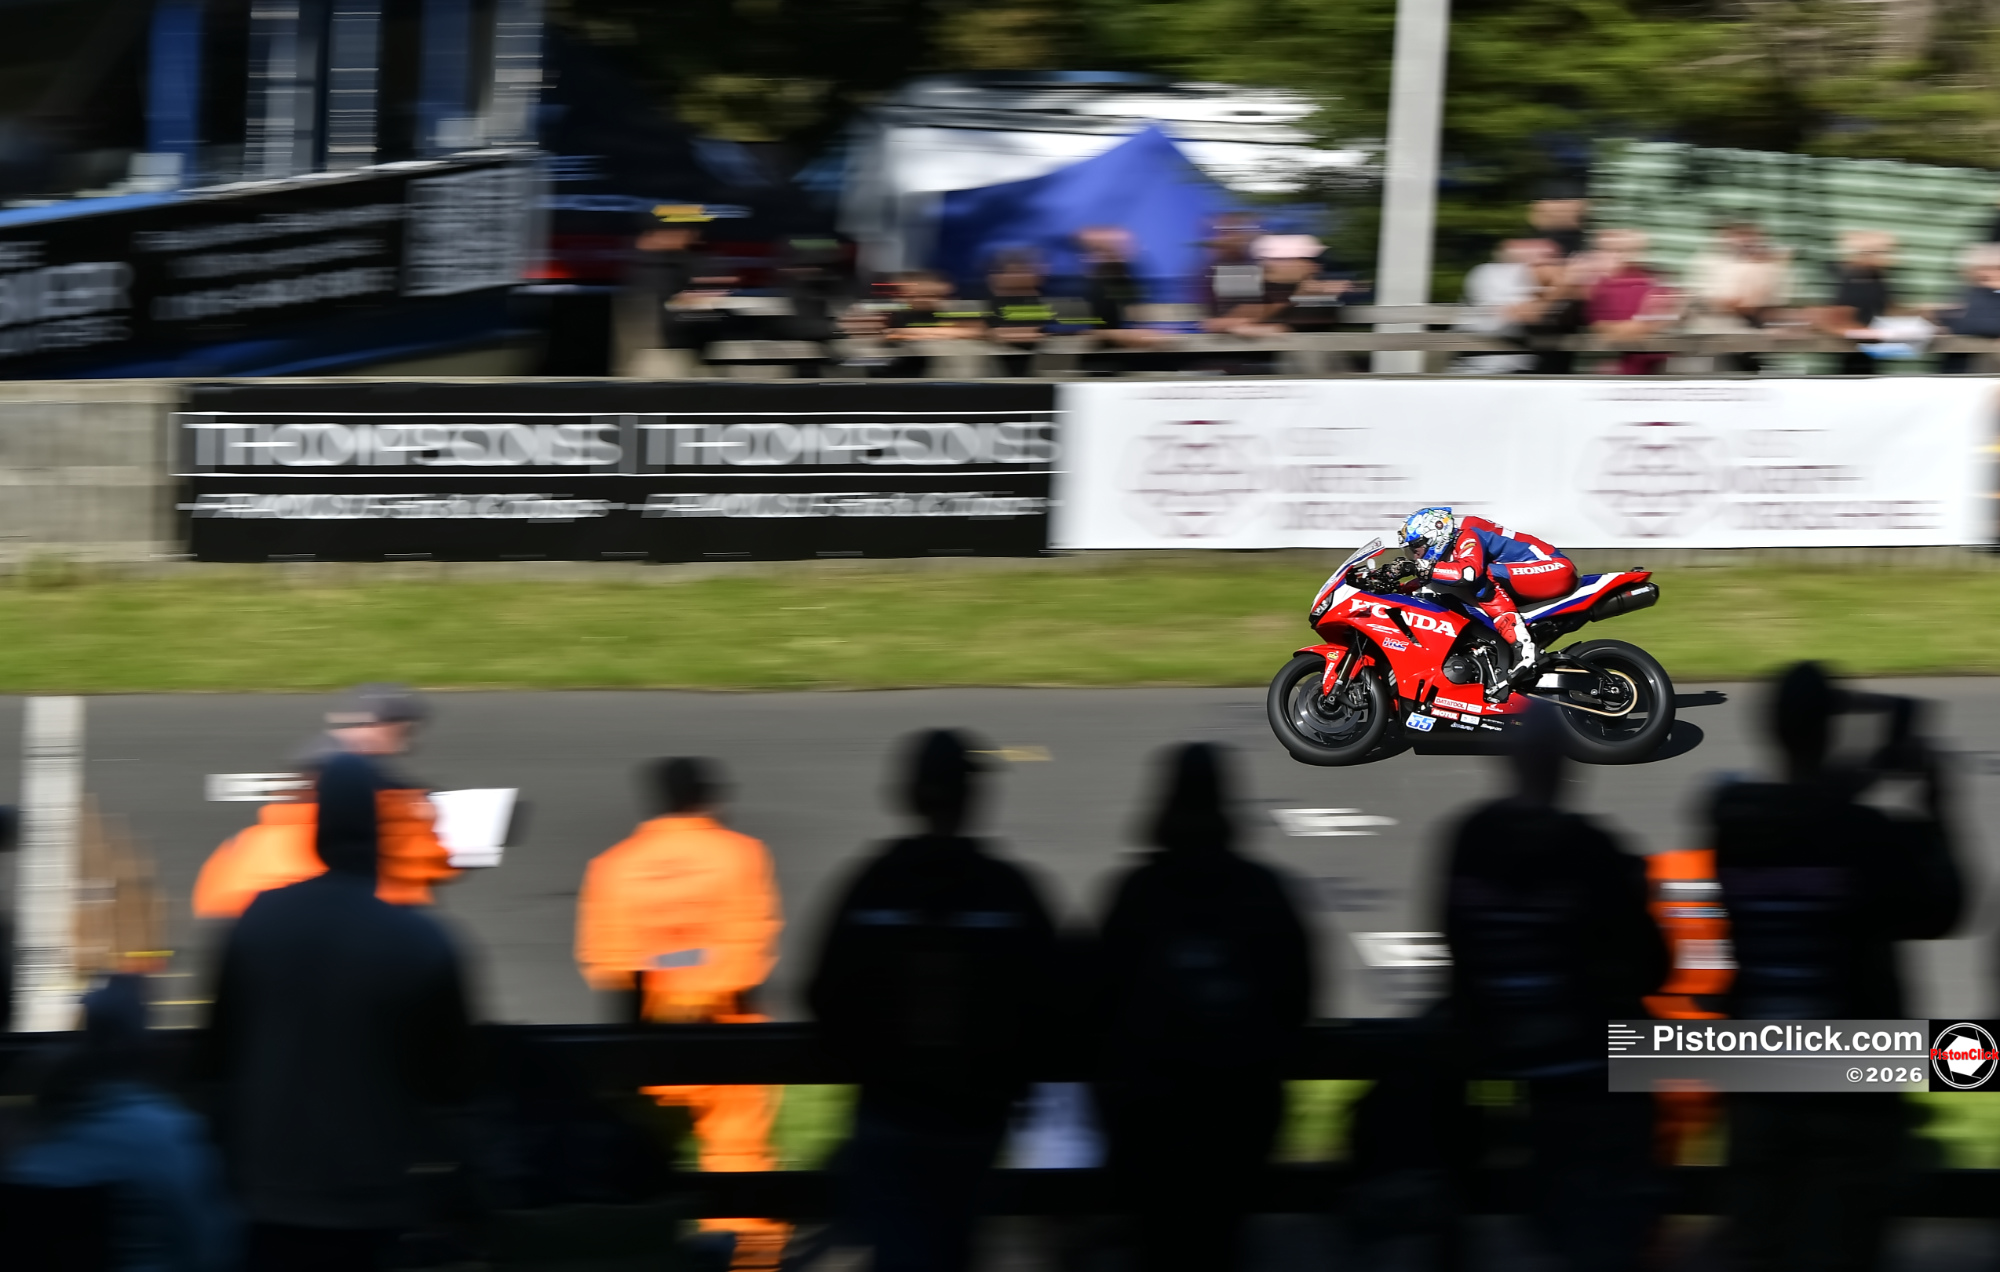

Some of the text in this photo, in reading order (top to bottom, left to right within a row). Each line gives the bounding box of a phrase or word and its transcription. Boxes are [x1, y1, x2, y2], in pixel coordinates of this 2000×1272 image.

[1511, 562, 1566, 576] HONDA
[1348, 598, 1457, 638] HONDA
[1431, 708, 1458, 719] MOTUL
[1407, 715, 1434, 730] 55
